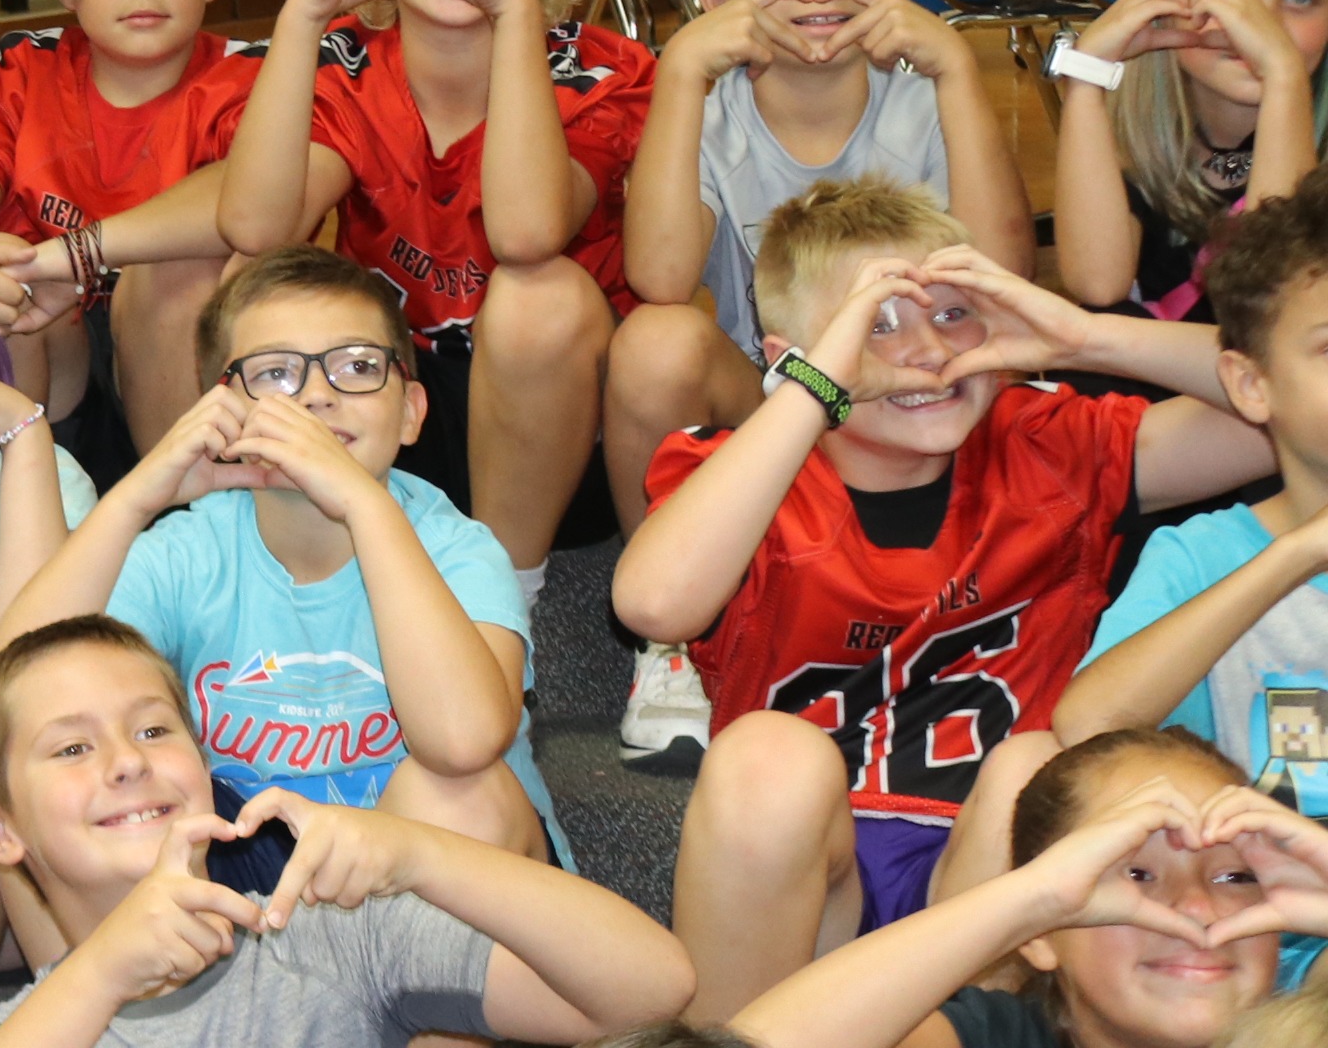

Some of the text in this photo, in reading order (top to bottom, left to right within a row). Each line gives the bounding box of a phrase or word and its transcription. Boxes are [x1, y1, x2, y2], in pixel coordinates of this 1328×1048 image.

[40, 191, 84, 230] RED
[387, 233, 434, 281] RED
[194, 659, 403, 771] Summe
